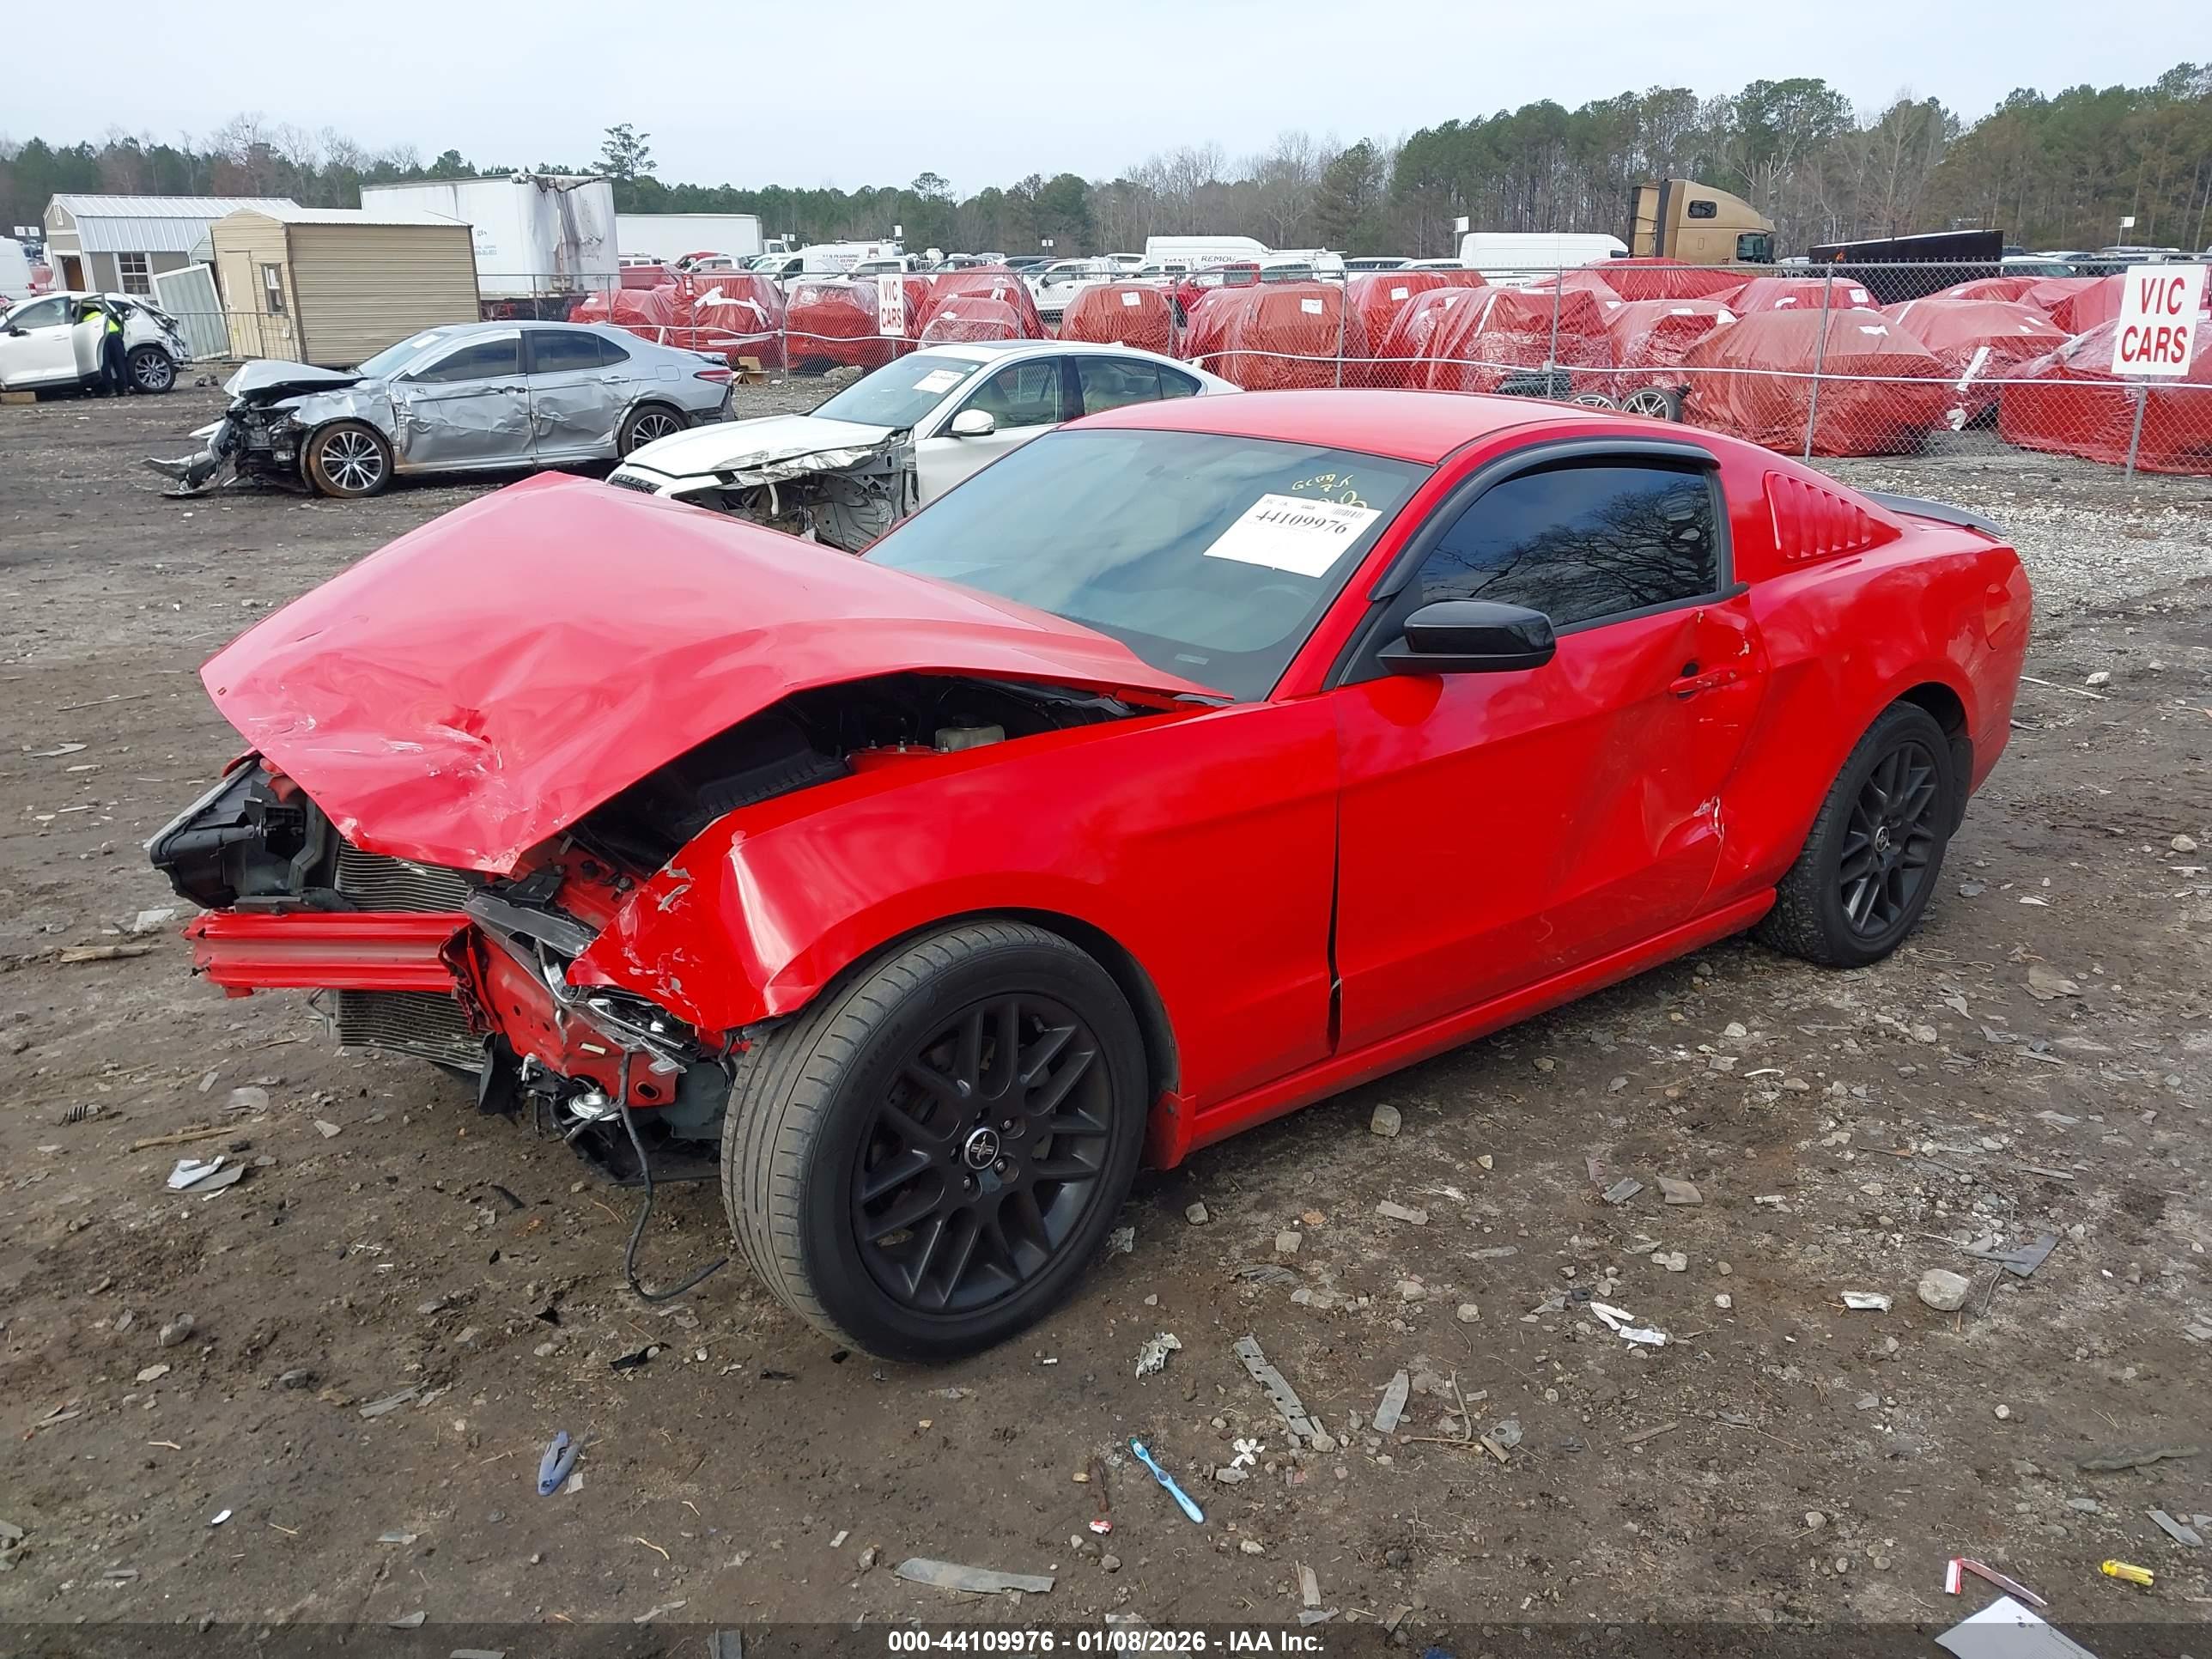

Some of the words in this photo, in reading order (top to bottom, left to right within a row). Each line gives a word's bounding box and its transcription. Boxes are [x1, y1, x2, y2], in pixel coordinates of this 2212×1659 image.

[883, 281, 898, 301] VIC
[2141, 277, 2185, 315] VIC
[881, 307, 902, 328] CARS
[2121, 325, 2188, 363] CARS
[1255, 510, 1352, 534] 44109976
